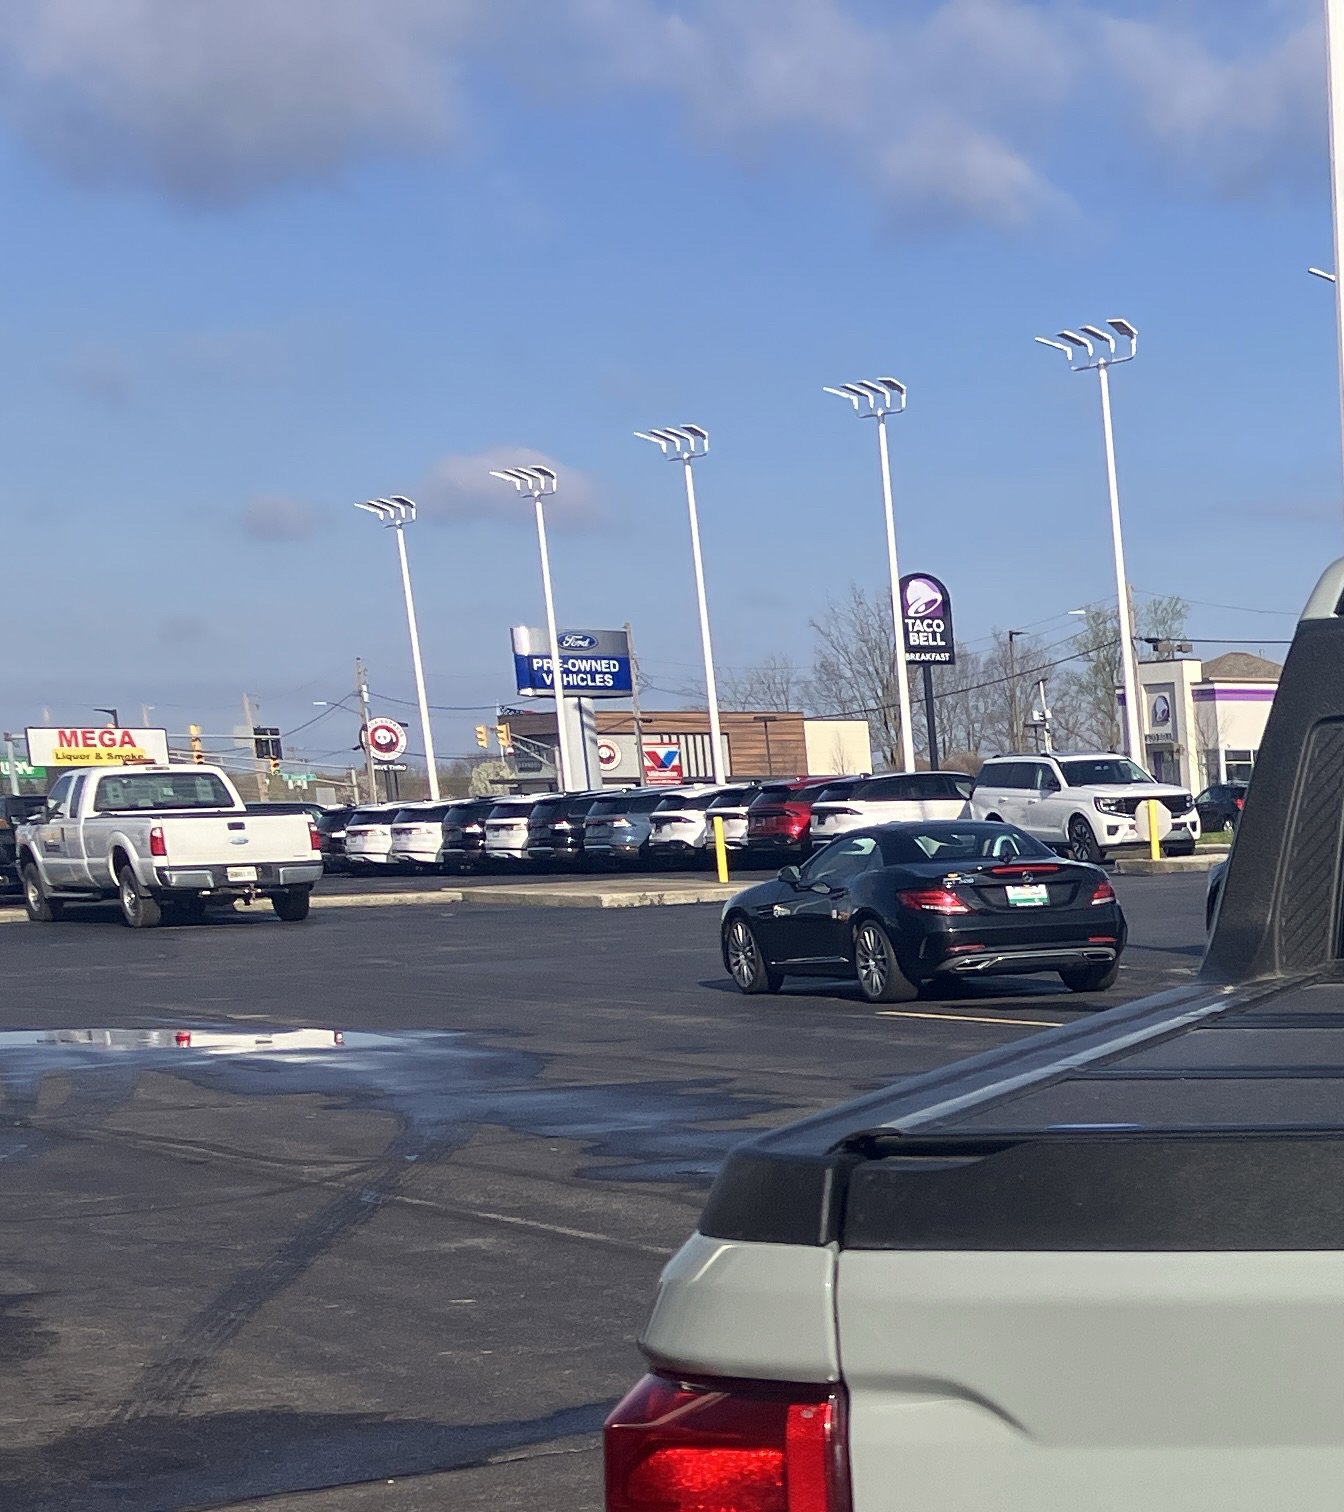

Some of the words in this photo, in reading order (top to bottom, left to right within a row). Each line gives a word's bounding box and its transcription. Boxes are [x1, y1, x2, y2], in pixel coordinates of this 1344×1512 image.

[905, 619, 945, 632] TACO
[562, 635, 592, 648] Ford
[909, 633, 946, 646] BELL
[905, 653, 950, 661] BREAKFAST
[542, 674, 614, 687] VHICLES
[58, 730, 137, 748] MEGA
[55, 752, 90, 762] Liquor
[95, 753, 103, 761] &
[106, 752, 145, 763] Smoke
